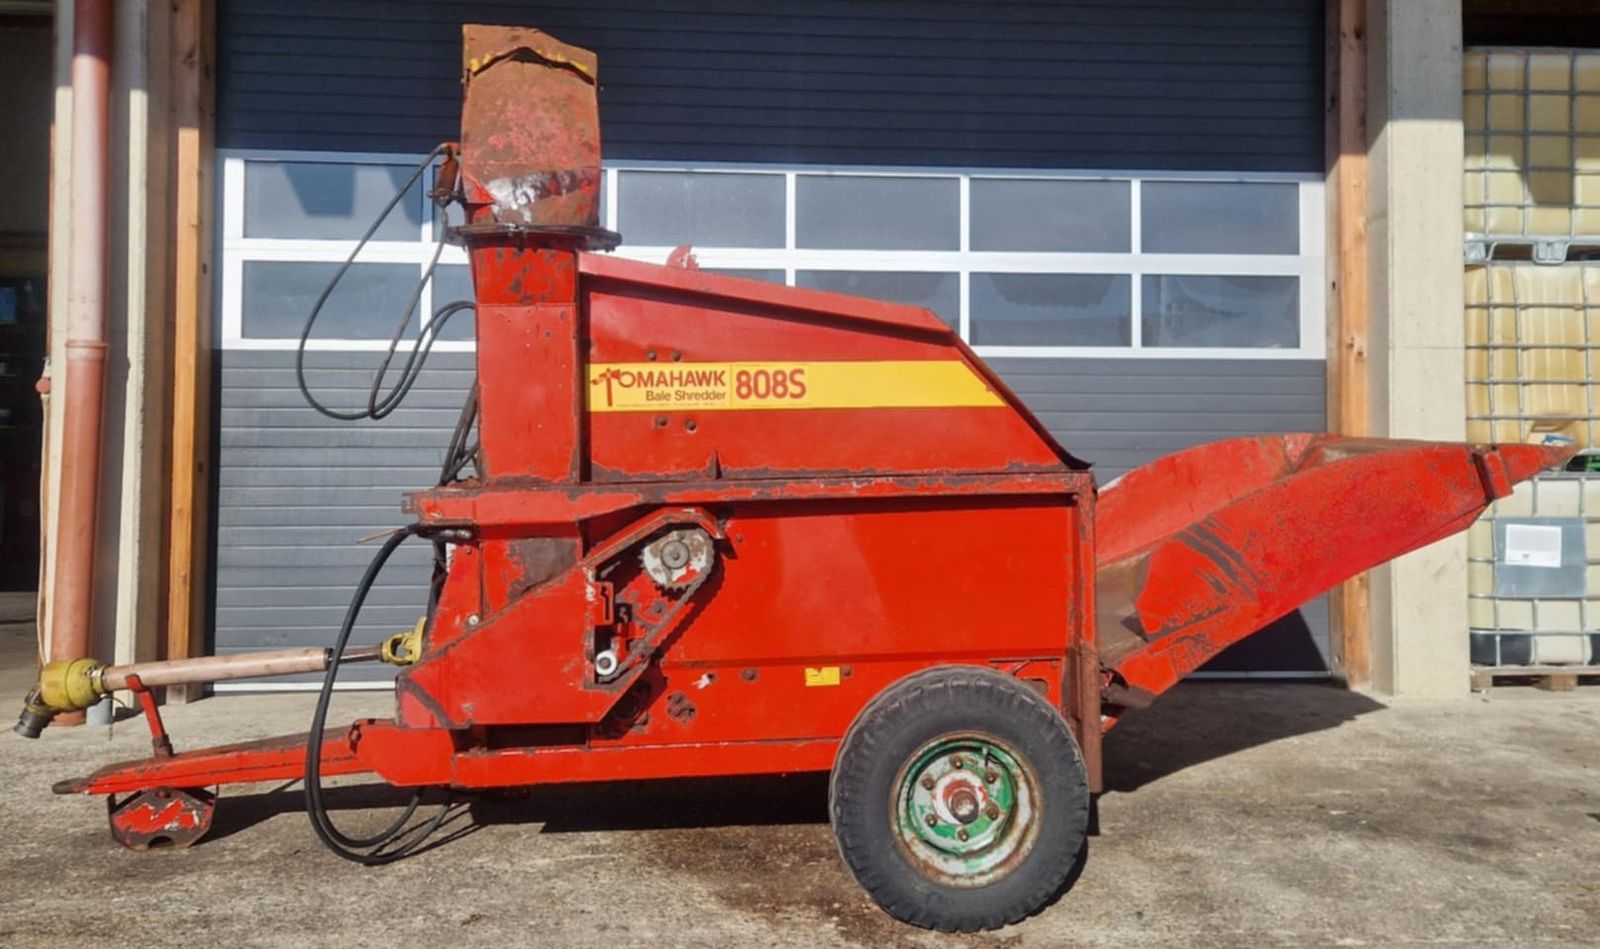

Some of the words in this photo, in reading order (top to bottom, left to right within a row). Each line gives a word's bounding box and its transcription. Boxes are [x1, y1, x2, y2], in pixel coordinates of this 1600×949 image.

[736, 368, 806, 399] 808S
[646, 390, 671, 402] Bale
[674, 390, 726, 402] Shredder
